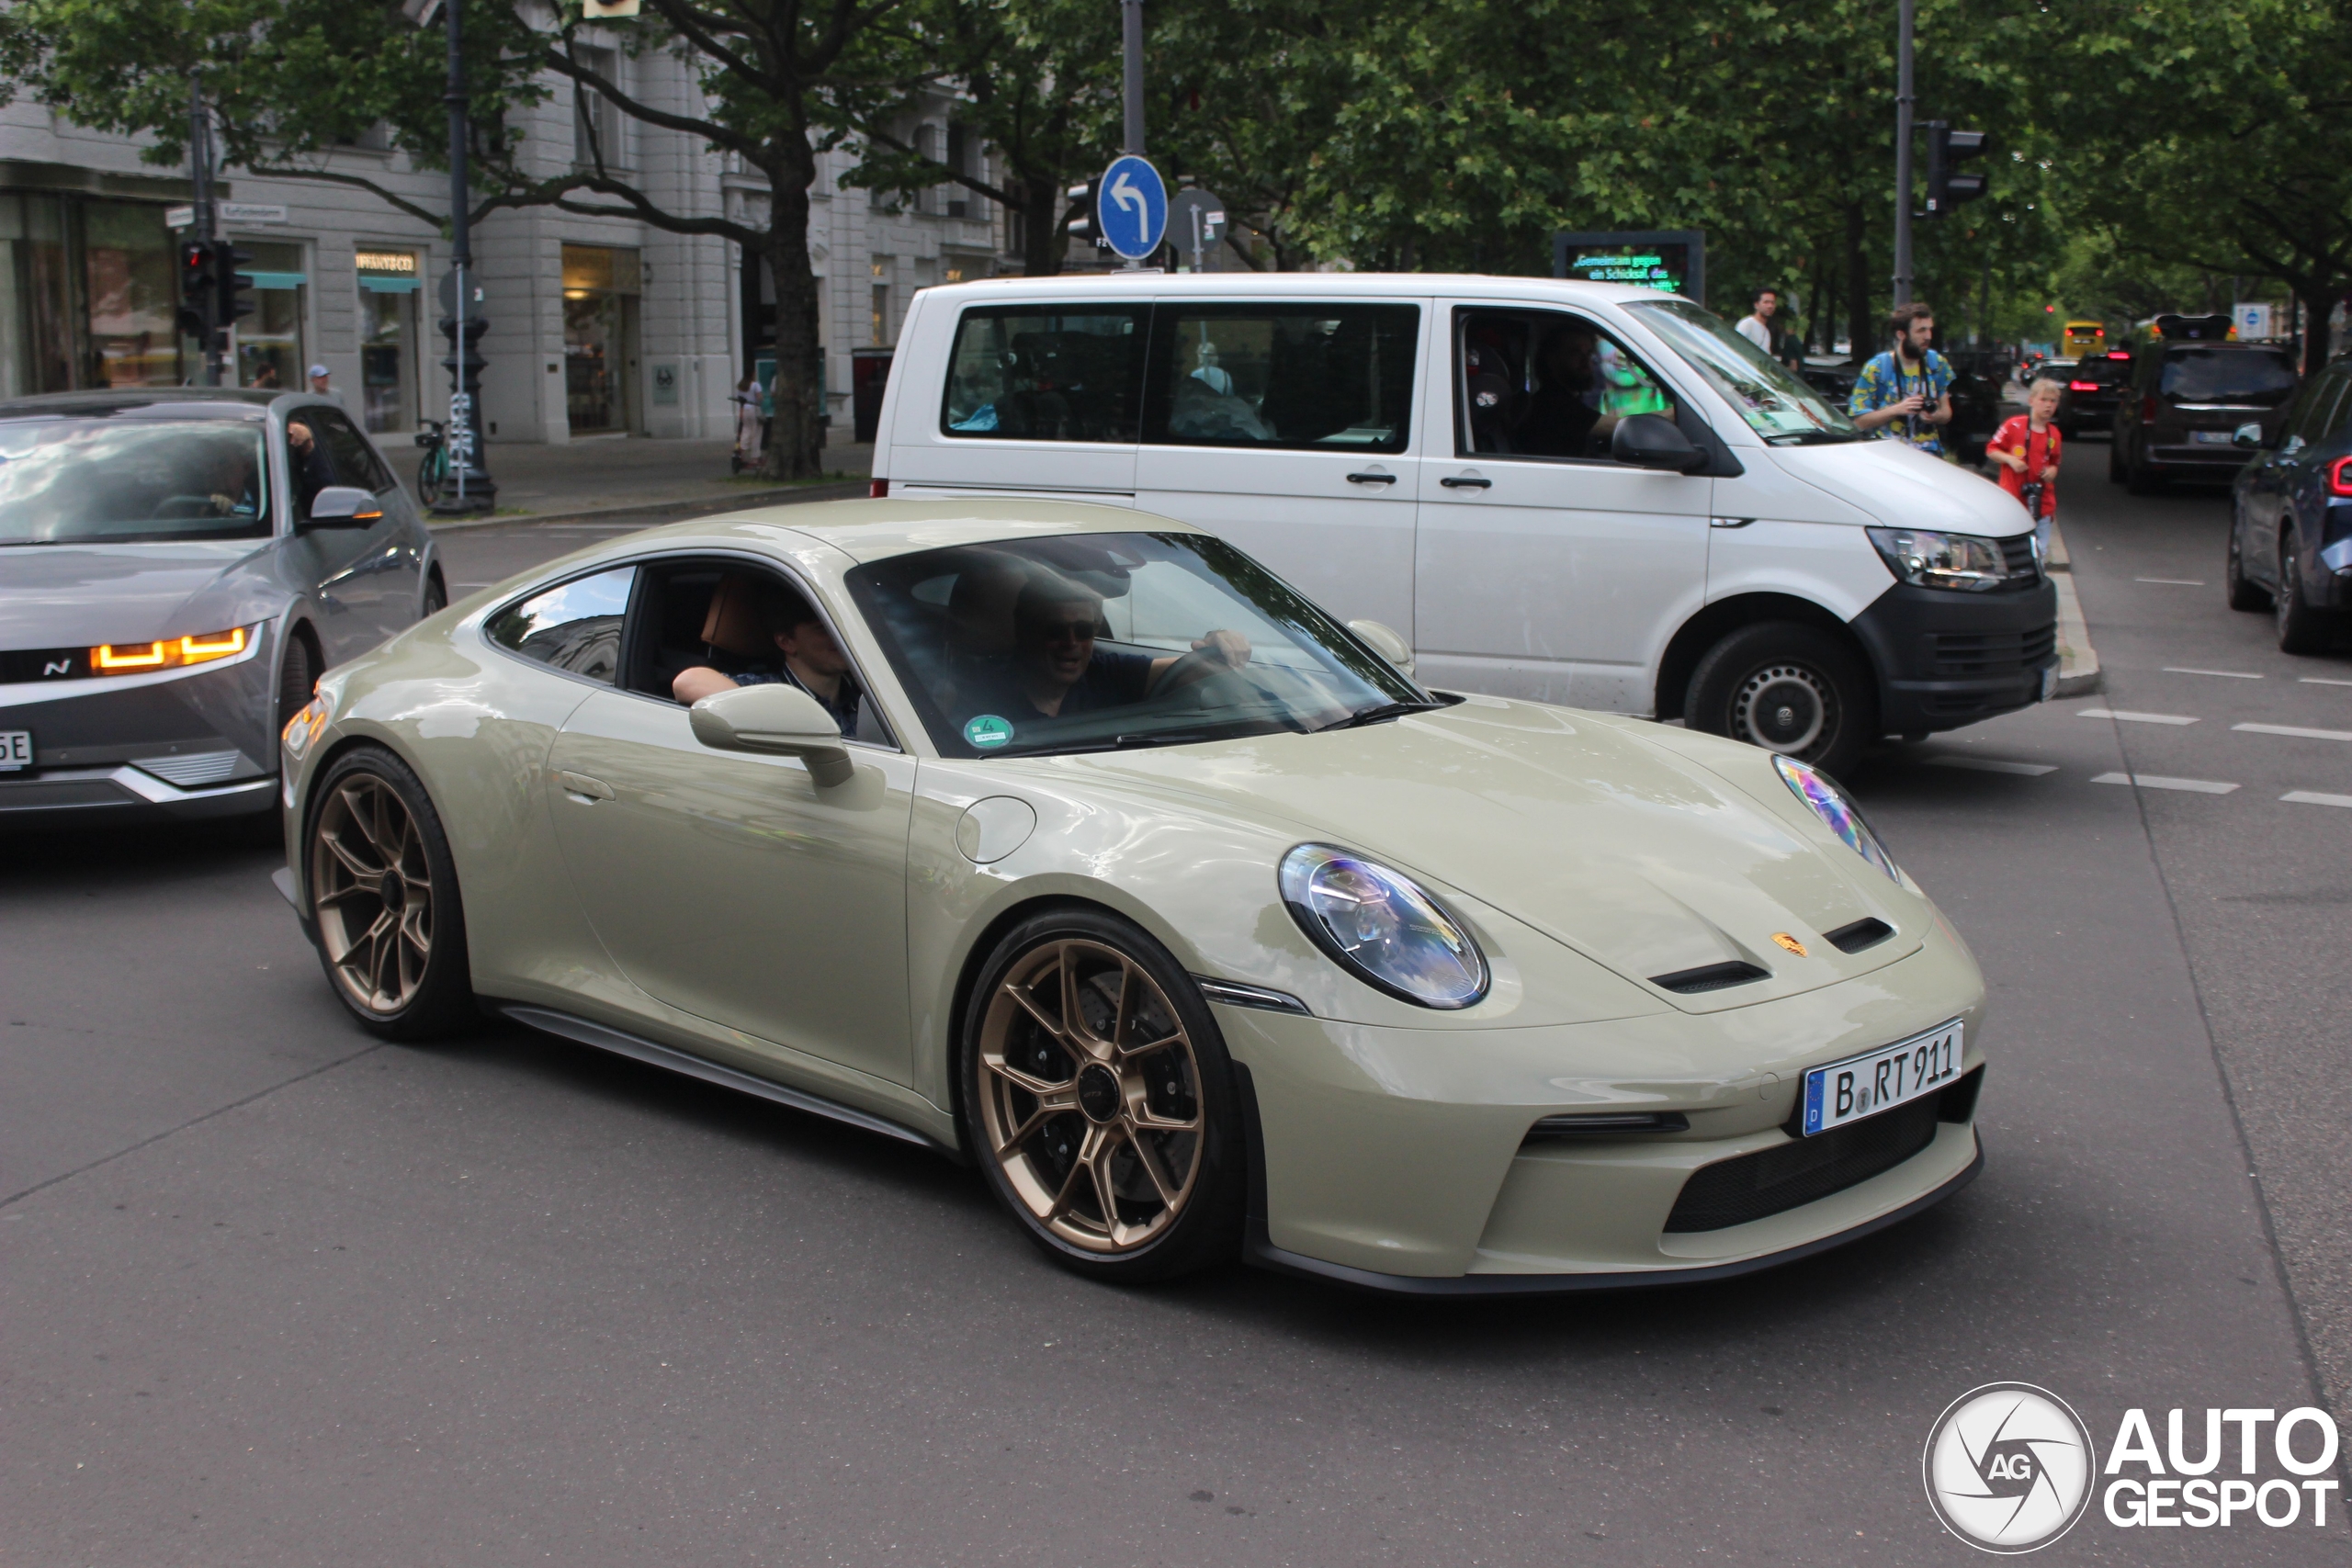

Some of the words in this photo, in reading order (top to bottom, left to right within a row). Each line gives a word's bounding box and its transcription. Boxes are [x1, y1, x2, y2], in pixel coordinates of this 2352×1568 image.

[1632, 256, 1661, 267] gegen
[1589, 270, 1604, 279] ein
[1605, 267, 1649, 279] Schicksal,
[1650, 268, 1668, 279] das
[982, 719, 994, 732] 4
[1836, 1070, 1855, 1119] B
[1874, 1052, 1909, 1106] RT
[1915, 1033, 1952, 1090] 911
[1810, 1109, 1818, 1122] D
